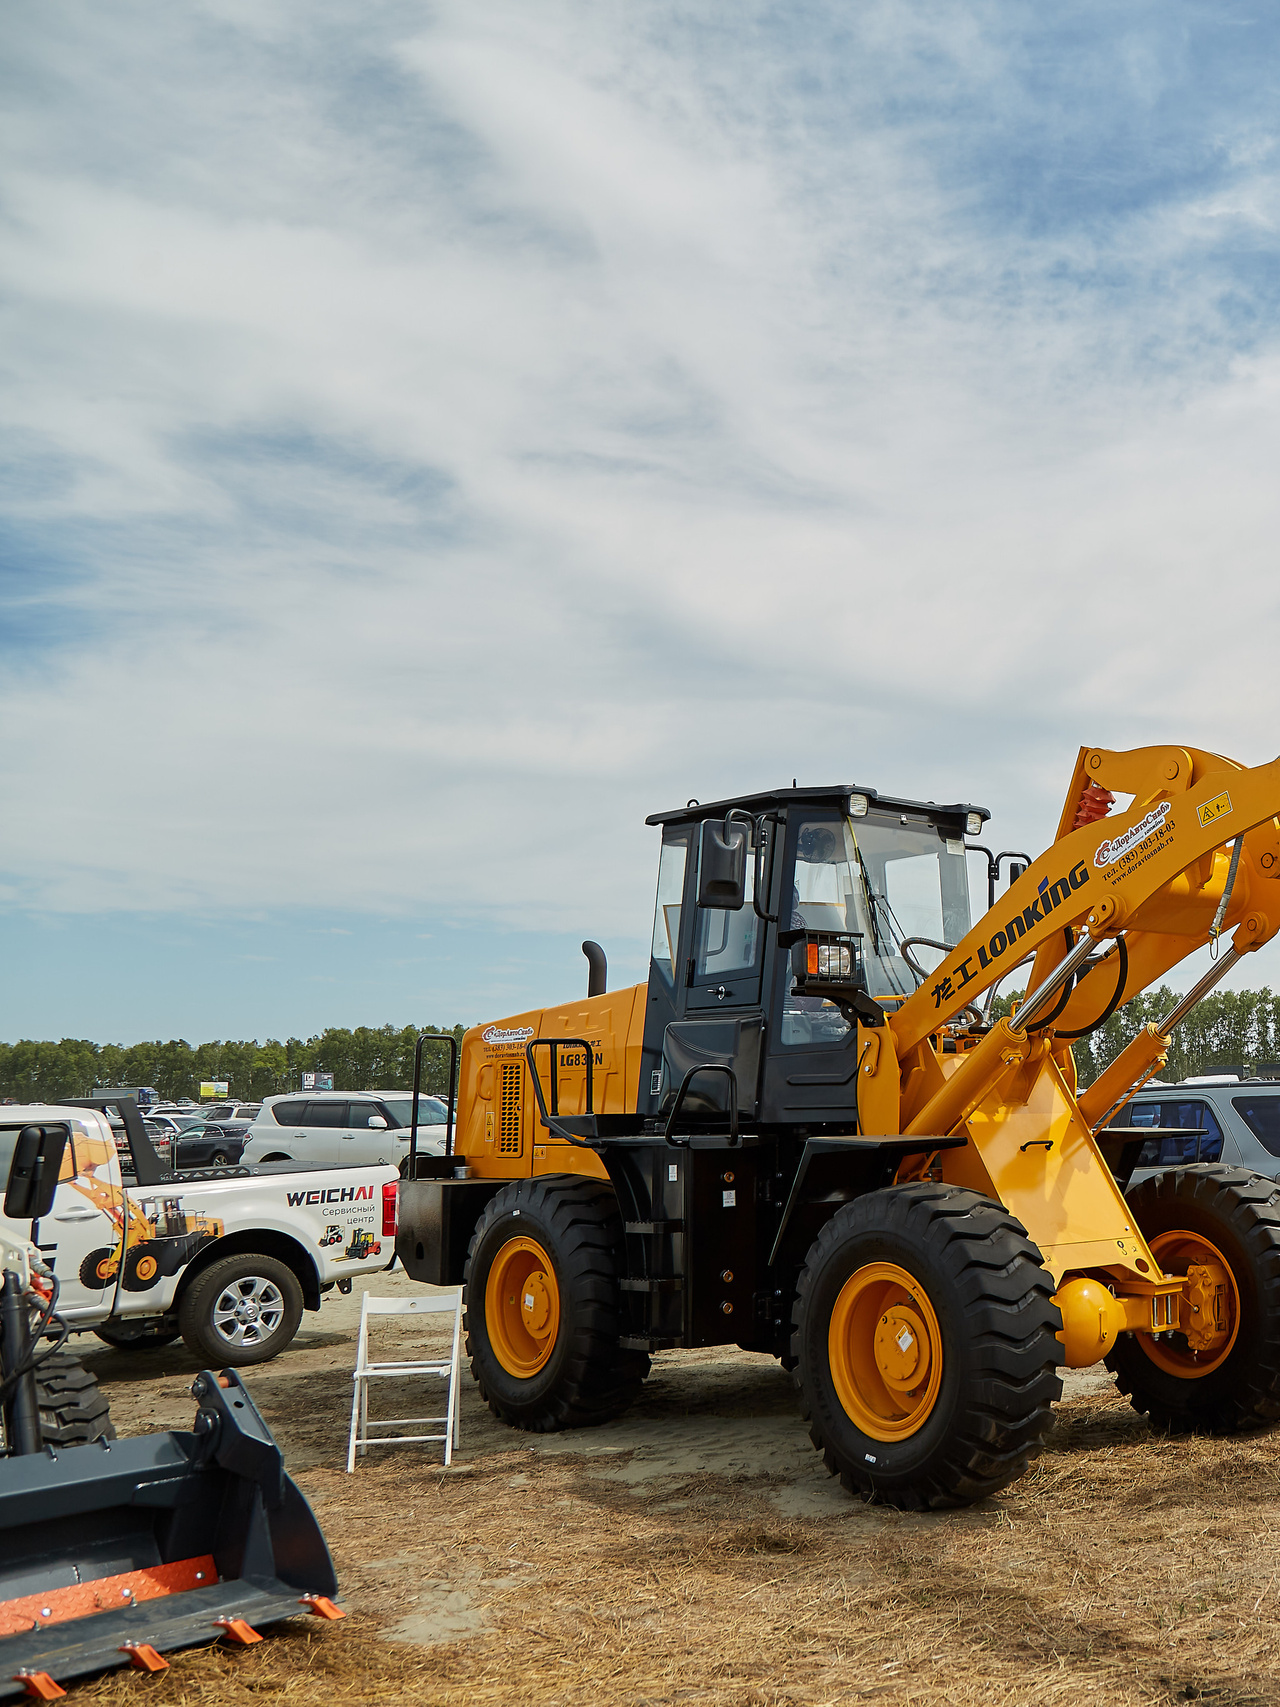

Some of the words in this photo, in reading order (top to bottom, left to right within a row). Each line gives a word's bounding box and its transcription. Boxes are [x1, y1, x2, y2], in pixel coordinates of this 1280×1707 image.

[1111, 803, 1170, 852] «ДорАвтоСнаб»
[1102, 868, 1119, 882] тел.
[1118, 849, 1139, 870] (383)
[1139, 820, 1176, 854] 303-18-03
[1111, 835, 1175, 886] www.doravtosnab.ru
[560, 1052, 603, 1067] LG83N
[286, 1185, 374, 1208] WEICHAI
[322, 1204, 376, 1217] Сервисный
[347, 1215, 375, 1225] центр
